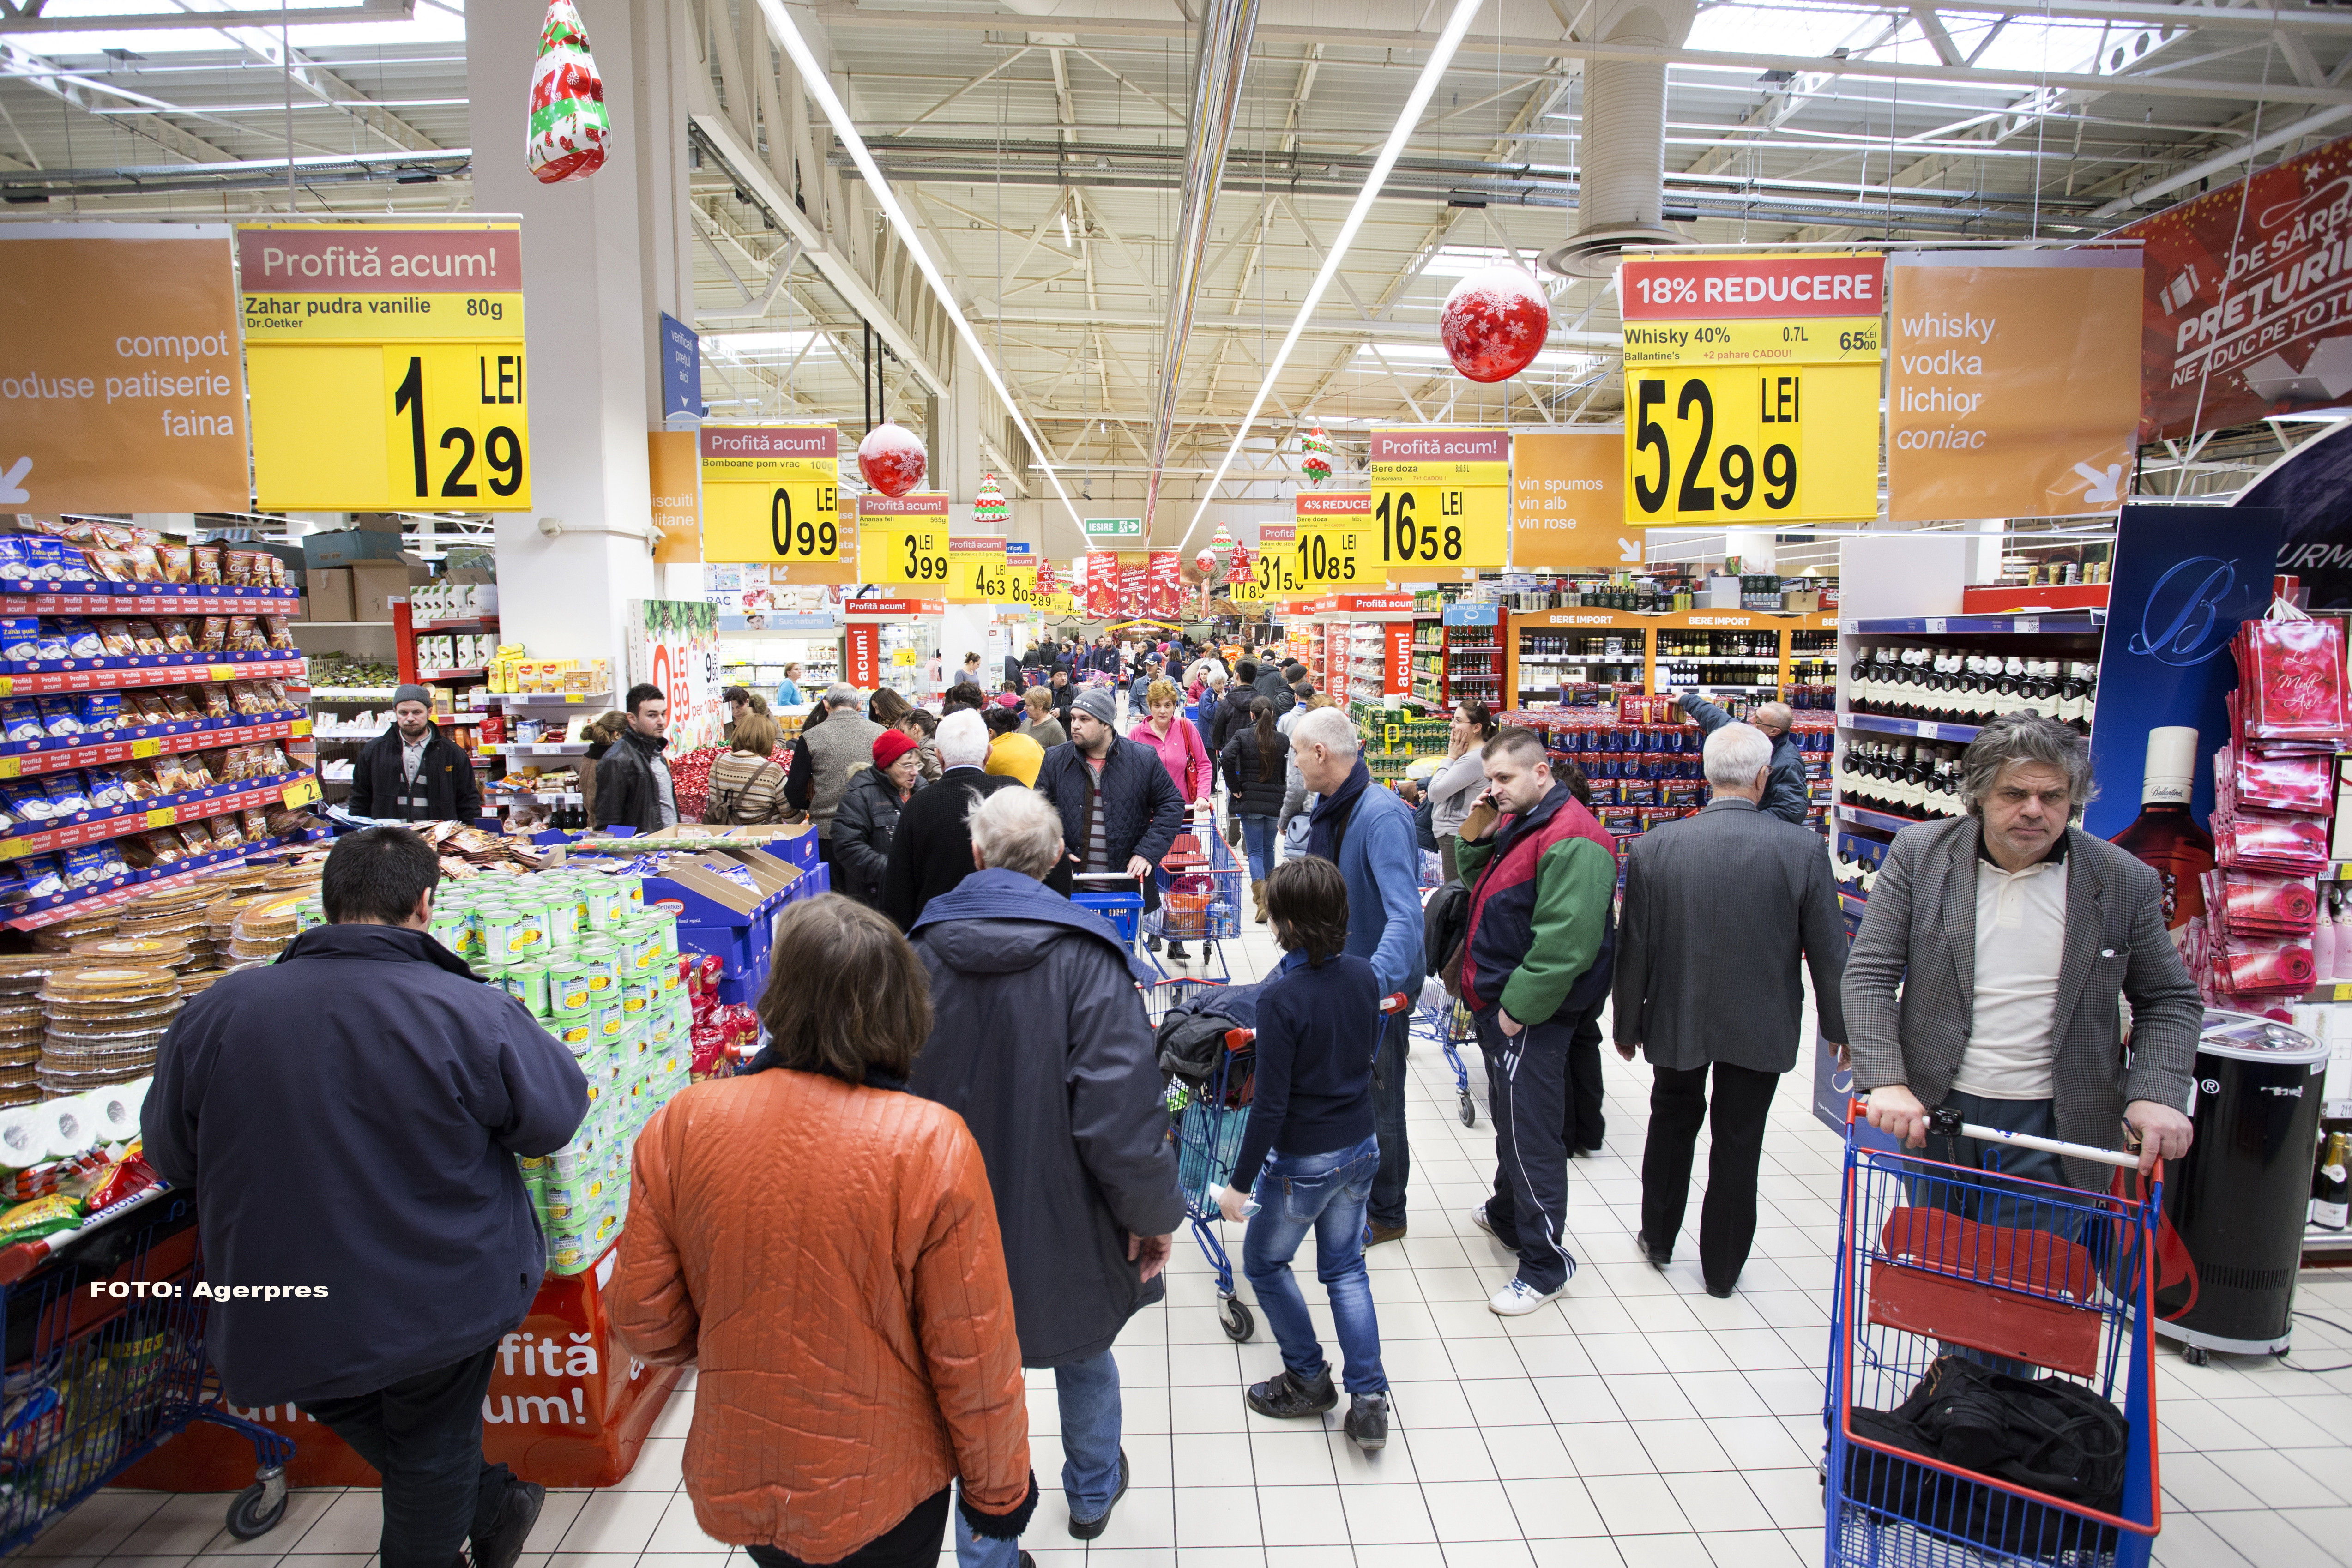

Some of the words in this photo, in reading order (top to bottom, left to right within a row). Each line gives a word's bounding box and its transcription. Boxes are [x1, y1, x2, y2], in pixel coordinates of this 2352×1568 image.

[2230, 241, 2267, 280] DE
[2270, 200, 2352, 259] SĂRB
[263, 246, 382, 277] Profită
[390, 248, 496, 276] acum!
[1636, 277, 1697, 303] 18%
[1704, 274, 1872, 303] REDUCERE
[246, 298, 300, 314] Zahar
[307, 298, 362, 317] pudra
[368, 298, 431, 314] vanilie
[466, 299, 503, 320] 80g
[247, 318, 303, 329] Dr.Oetker
[1901, 312, 1996, 345] whisky
[116, 329, 228, 363] compot
[1624, 329, 1688, 347] Whisky
[1694, 327, 1731, 344] 40%
[1782, 326, 1808, 343] 0.7L
[1624, 352, 1680, 361] Ballantine's
[1703, 351, 1715, 359] +2
[1717, 350, 1750, 362] pahare
[1752, 349, 1792, 359] CADOU!
[1901, 350, 1982, 375] vodka
[2171, 362, 2198, 389] NE
[2259, 318, 2288, 348] PE
[0, 372, 94, 399] oduse
[106, 369, 230, 404] patiserie
[481, 356, 521, 404] LEI
[679, 369, 688, 384] aici
[1762, 377, 1798, 422] LEI
[1901, 386, 1981, 412] lichior
[161, 409, 234, 437] faina
[712, 434, 770, 450] Profită
[773, 435, 826, 450] acum!
[1383, 439, 1440, 454] Profită
[1444, 440, 1496, 454] acum!
[1897, 425, 1986, 450] coniac
[702, 459, 753, 467] Bomboane
[810, 461, 833, 471] 100g
[1371, 464, 1393, 473] Bere
[1518, 477, 1539, 490] vin
[1544, 478, 1603, 493] spumos
[651, 493, 693, 507] iscuiti
[817, 488, 837, 511] LEI
[866, 501, 904, 511] Profită
[907, 501, 941, 511] acum!
[1304, 500, 1321, 509] 4%
[1442, 491, 1462, 516] LEI
[1518, 496, 1539, 509] vin
[1544, 496, 1566, 510] alb
[651, 513, 694, 526] olitane
[1089, 523, 1114, 531] IESIRE
[1518, 516, 1539, 529] vin
[1544, 519, 1576, 529] rose
[919, 535, 933, 550] LEI
[1343, 534, 1356, 550] LEI
[2275, 543, 2352, 568] URM
[996, 565, 1005, 575] LEI
[850, 602, 877, 610] Profită
[1357, 599, 1387, 608] Profită
[1550, 615, 1575, 624] BERE
[1576, 615, 1613, 624] IMPORT
[1689, 617, 1713, 625] BERE
[1715, 617, 1750, 625] IMPORT
[673, 647, 688, 678] LEI
[853, 630, 868, 681] acum!
[1396, 633, 1410, 687] acum!
[496, 1333, 599, 1377] fită
[483, 1388, 585, 1424] um!
